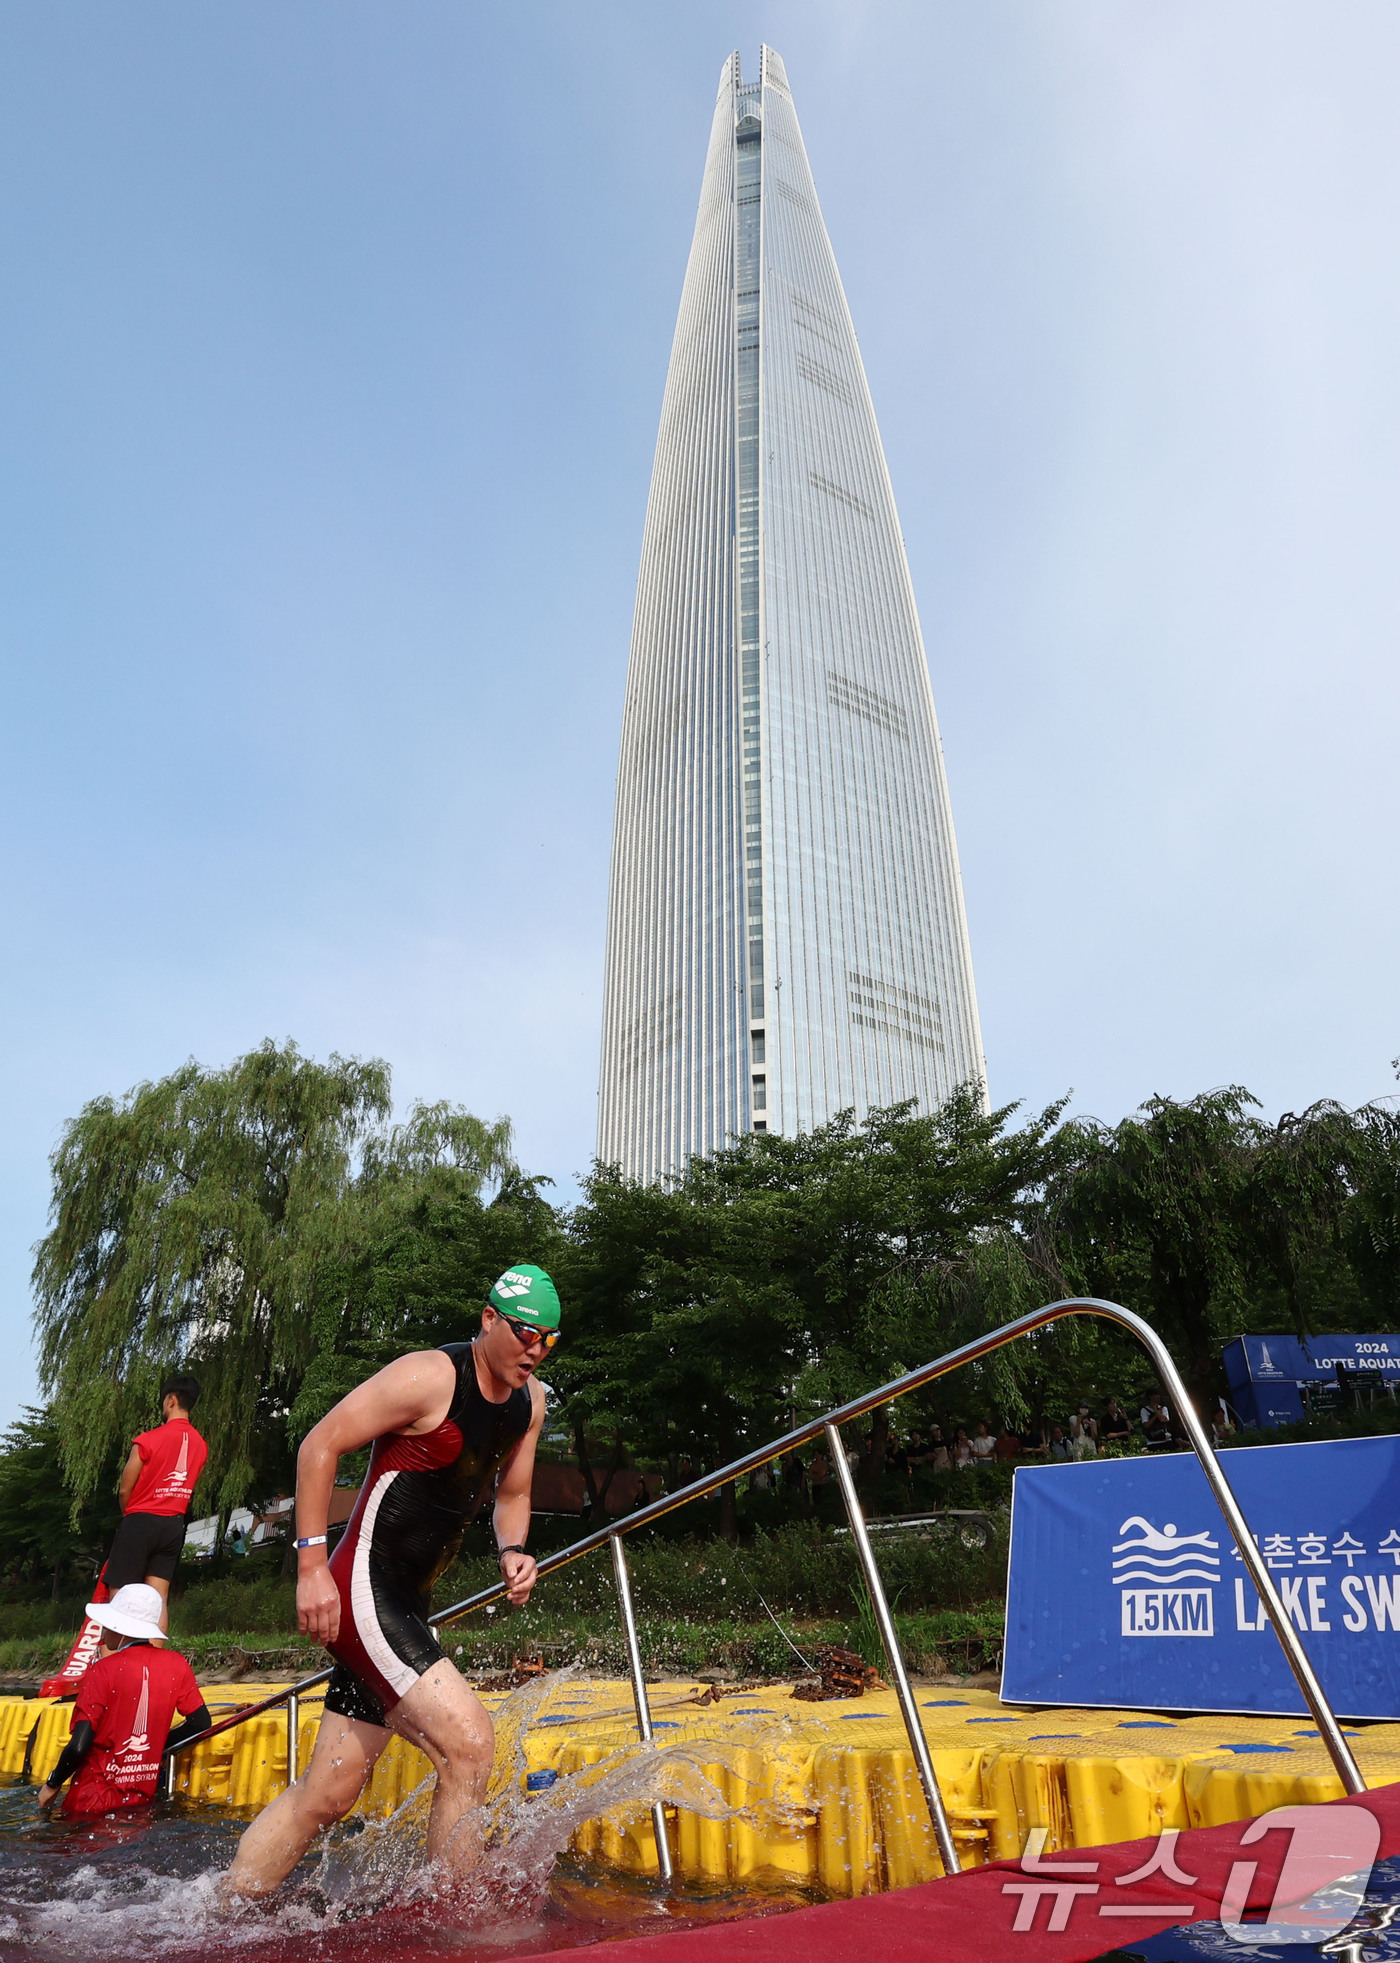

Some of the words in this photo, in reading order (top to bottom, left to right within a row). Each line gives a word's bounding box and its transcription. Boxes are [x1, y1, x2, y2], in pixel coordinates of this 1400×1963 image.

[516, 1305, 539, 1316] arena
[1354, 1342, 1389, 1353] 2024
[1126, 1594, 1209, 1632] 1.5KM
[62, 1620, 103, 1677] GUARD
[123, 1753, 143, 1763] 2024
